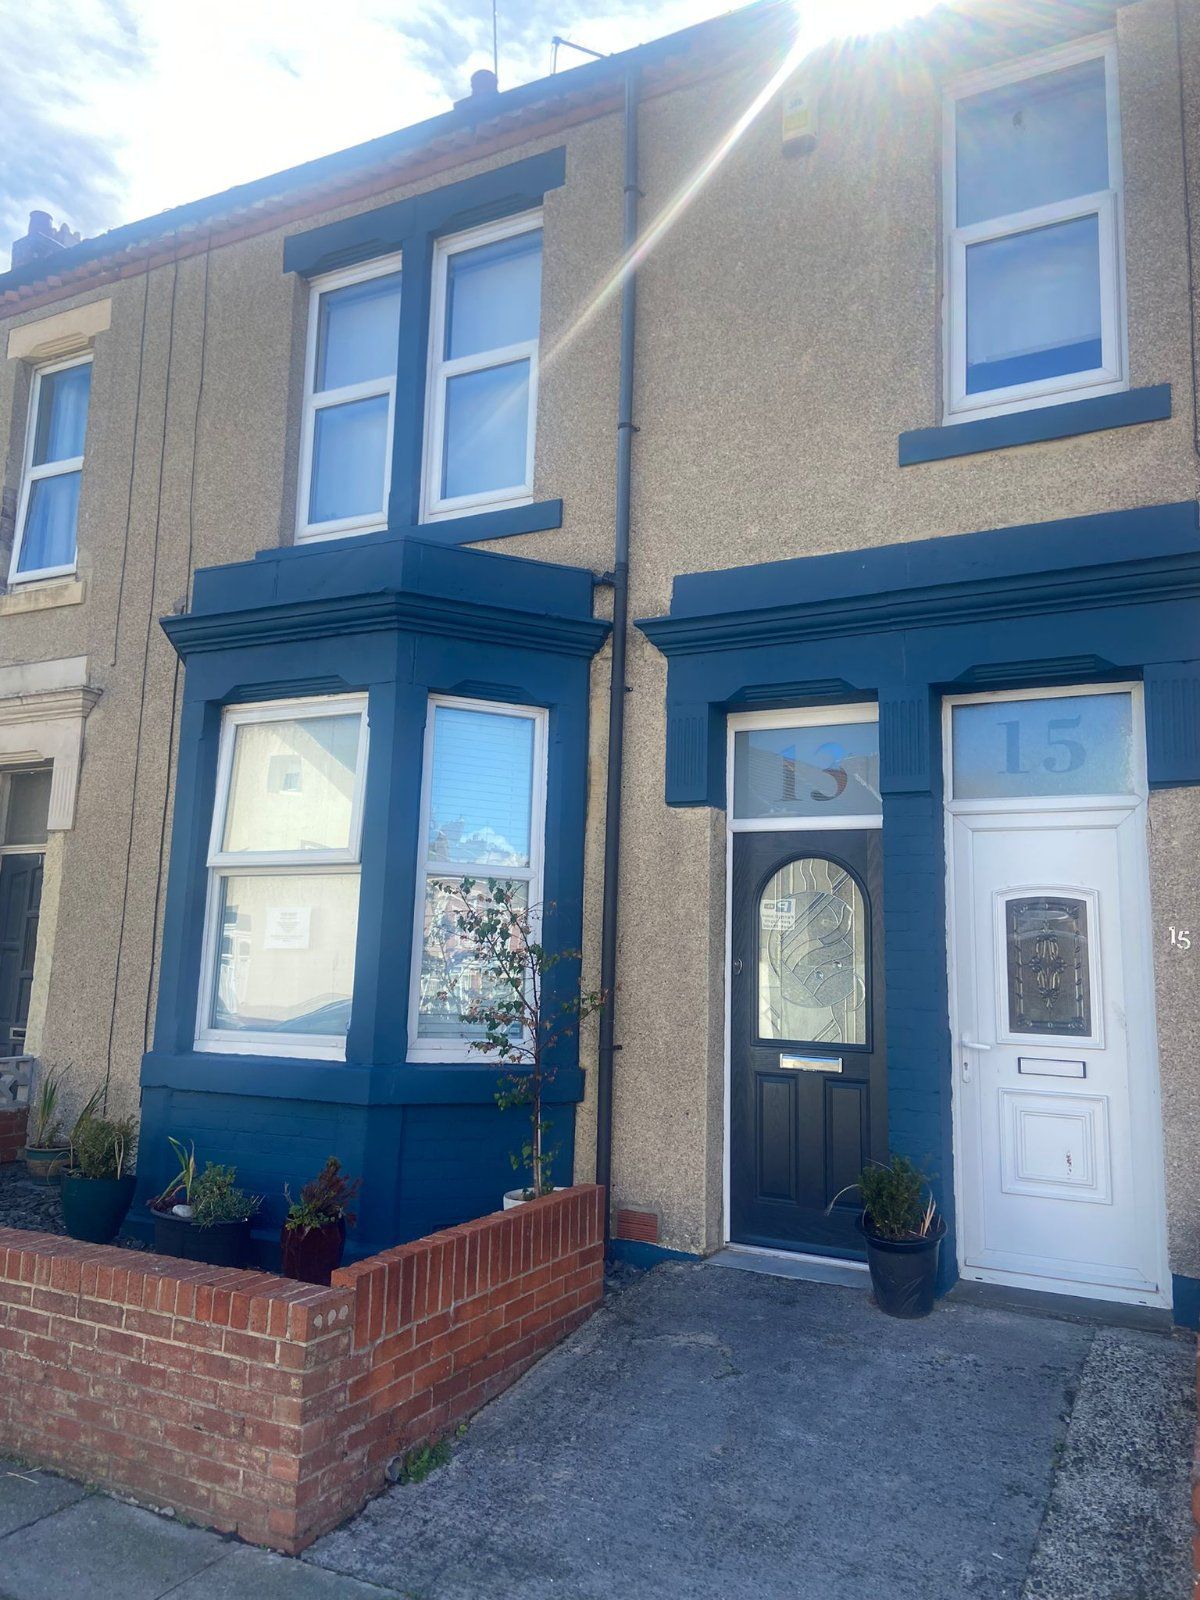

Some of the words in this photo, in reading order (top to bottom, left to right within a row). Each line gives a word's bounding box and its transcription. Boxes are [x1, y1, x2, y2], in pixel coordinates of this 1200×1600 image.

[780, 743, 848, 801] 13
[996, 714, 1086, 774] 15
[1168, 926, 1190, 950] 15
